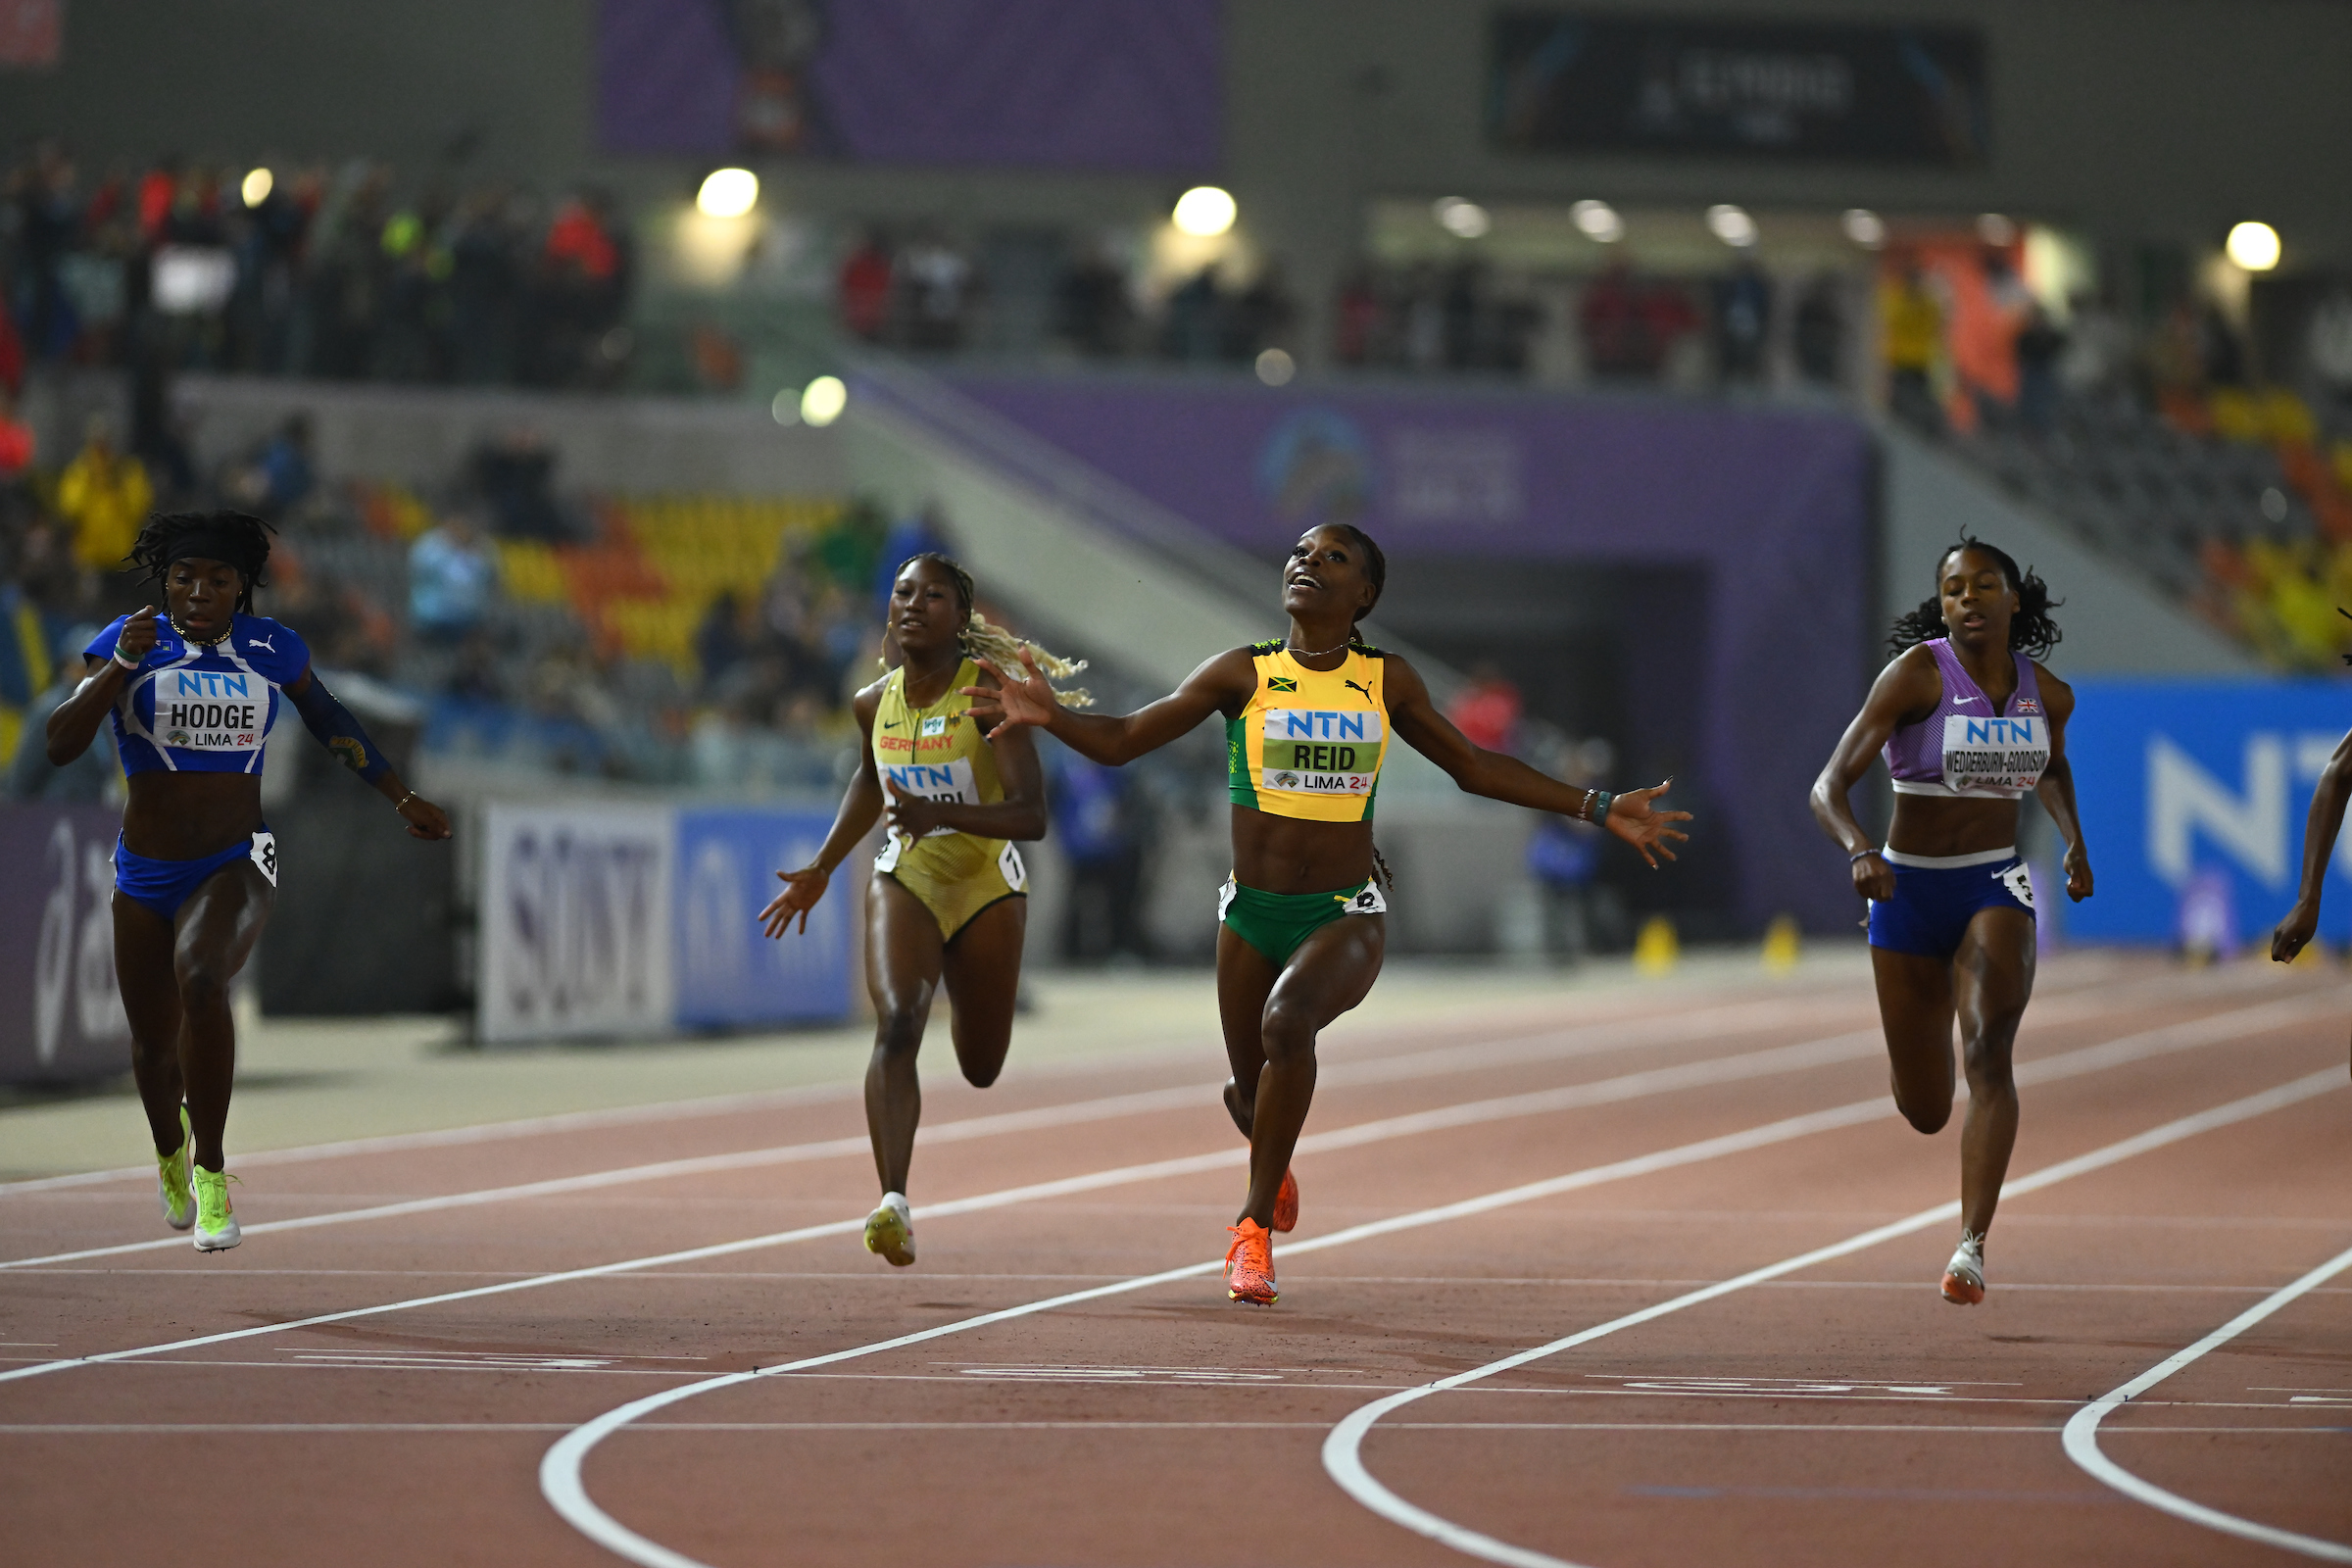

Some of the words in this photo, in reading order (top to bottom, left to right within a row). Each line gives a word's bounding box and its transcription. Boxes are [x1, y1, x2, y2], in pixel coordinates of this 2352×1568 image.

[178, 671, 248, 698] NTN
[171, 704, 256, 730] HODGE
[1288, 710, 1363, 740] NTN
[195, 733, 232, 747] LIMA
[236, 733, 254, 747] 24
[880, 735, 955, 753] GERMANY
[1967, 718, 2033, 745] NTN
[1294, 744, 1355, 771] REID
[889, 764, 954, 789] NTN
[1304, 774, 1346, 790] LIMA
[1349, 776, 1368, 789] 24
[1976, 776, 2013, 787] LIMA
[2016, 776, 2036, 788] 24
